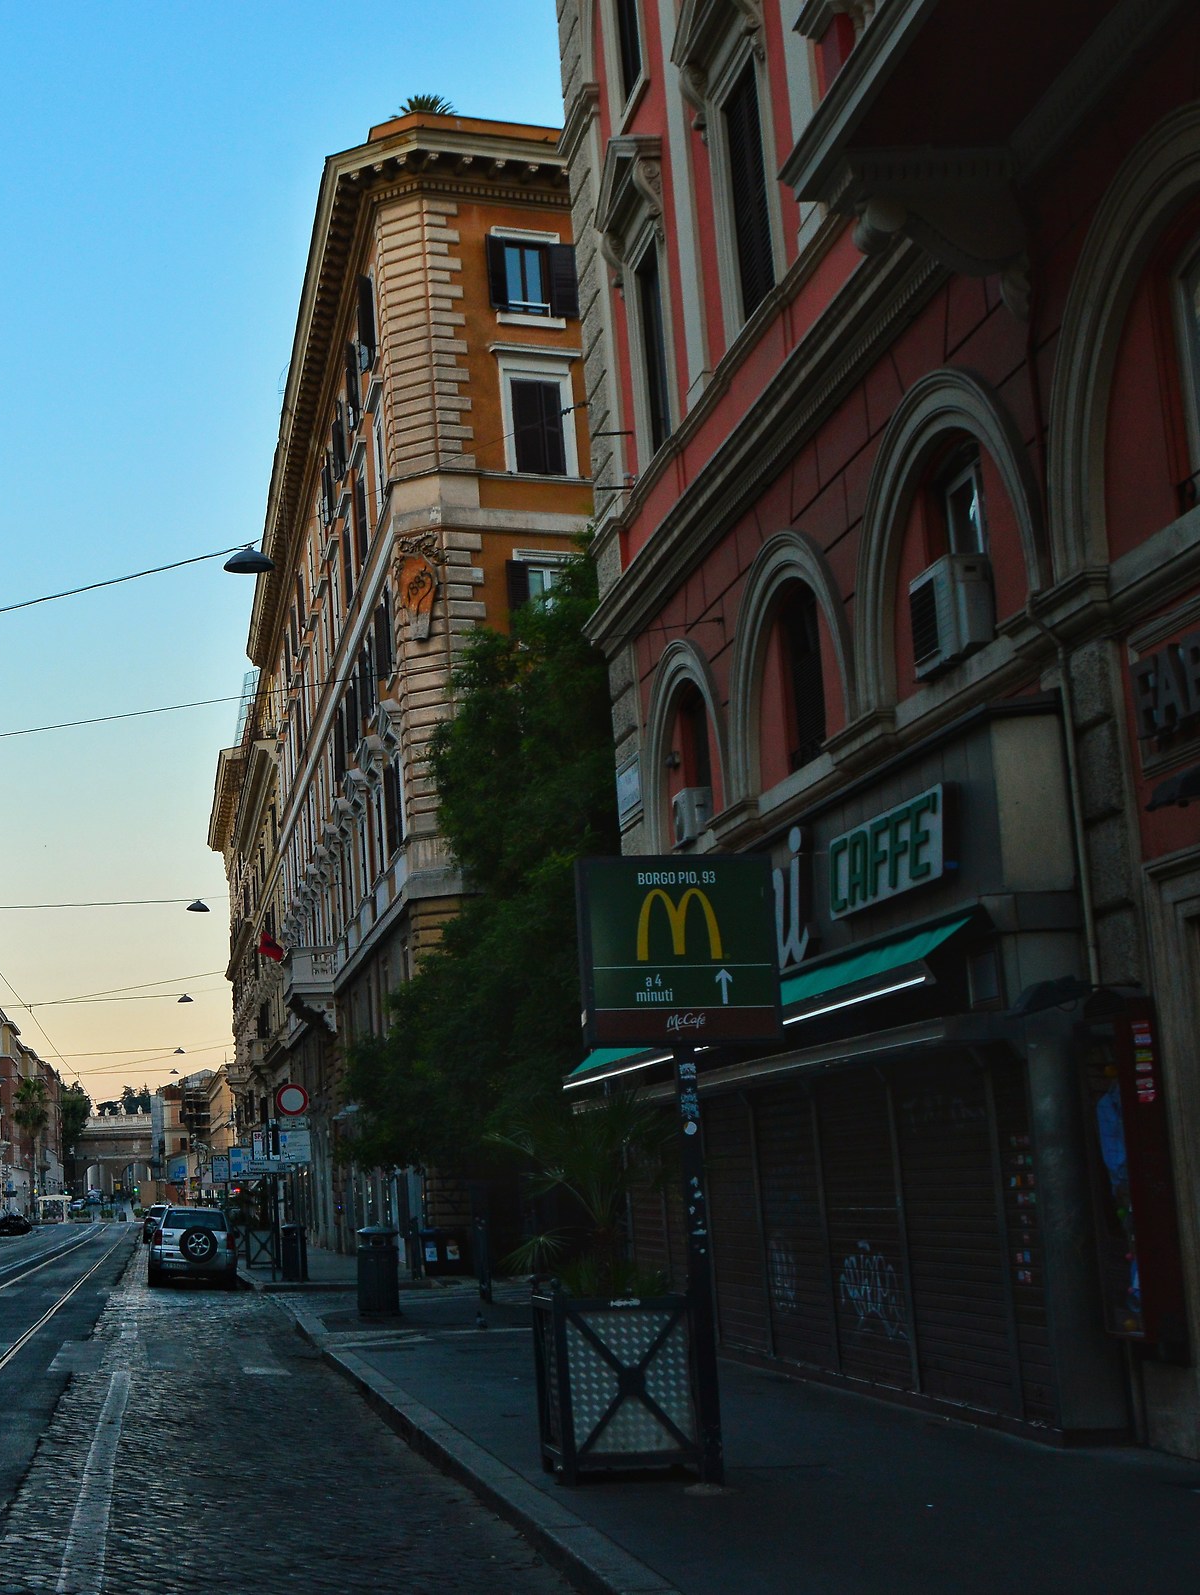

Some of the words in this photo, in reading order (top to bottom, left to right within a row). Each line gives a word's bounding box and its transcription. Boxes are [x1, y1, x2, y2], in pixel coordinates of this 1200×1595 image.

[638, 873, 676, 885] BORGO
[678, 872, 701, 886] PIO,
[702, 871, 717, 884] 93
[646, 977, 653, 987] a
[655, 973, 663, 986] 4
[636, 988, 673, 1002] minuti
